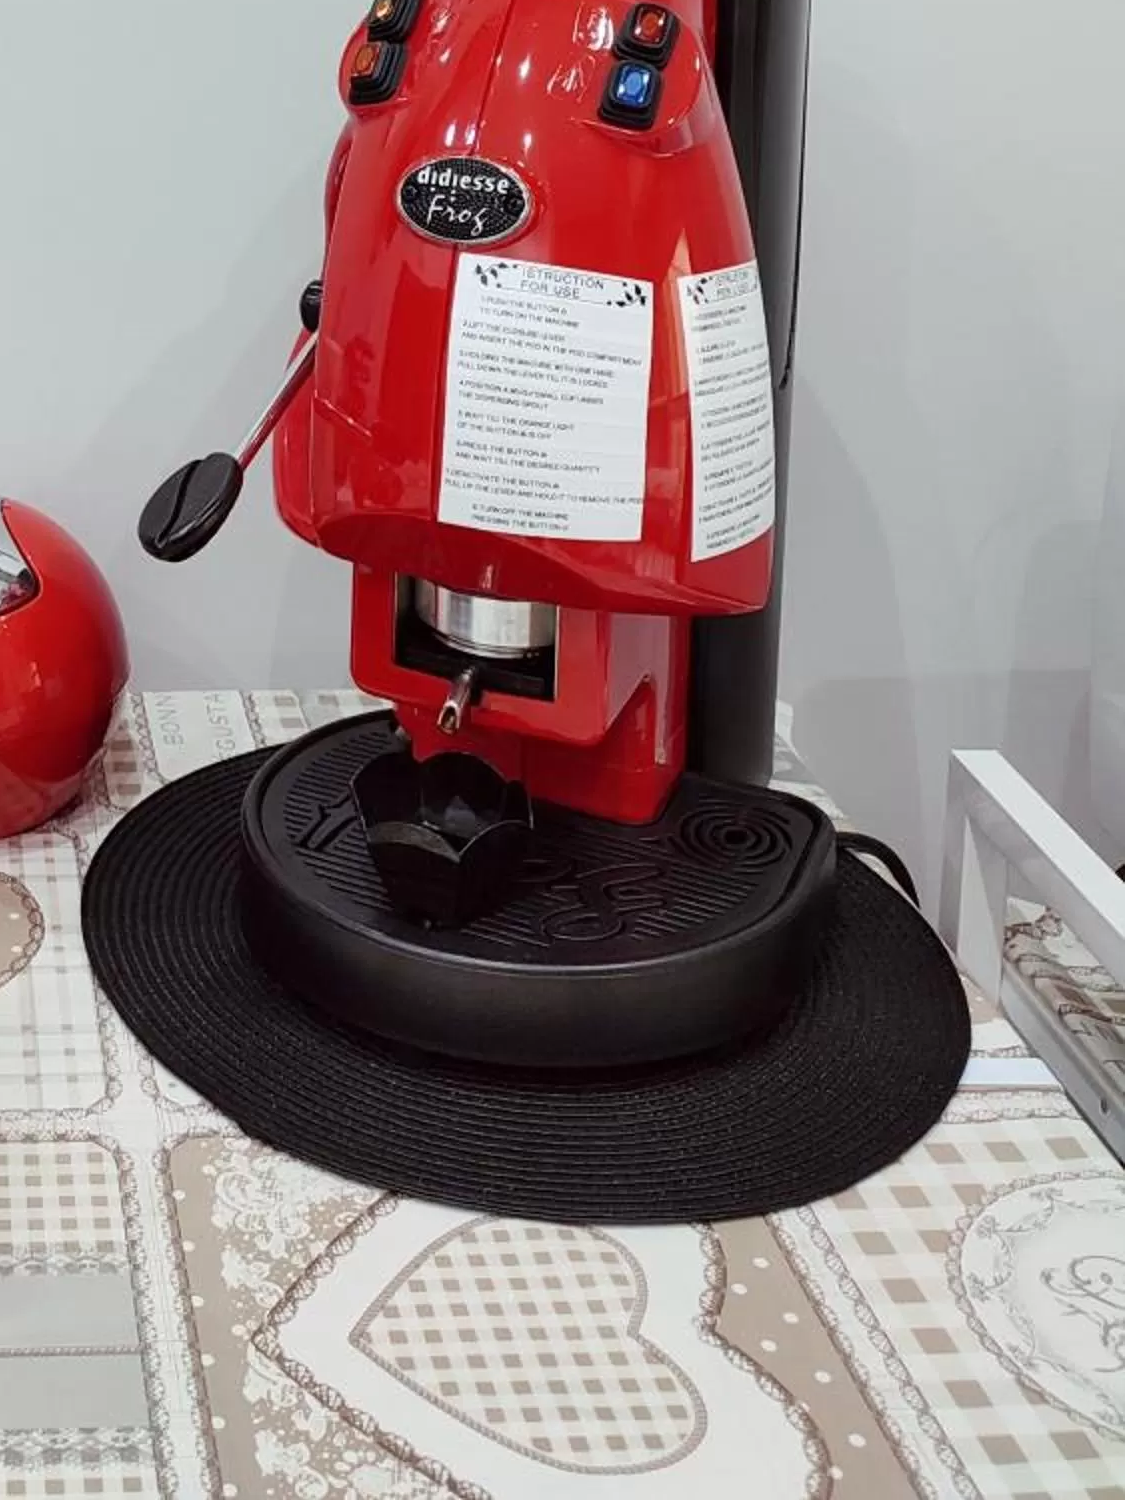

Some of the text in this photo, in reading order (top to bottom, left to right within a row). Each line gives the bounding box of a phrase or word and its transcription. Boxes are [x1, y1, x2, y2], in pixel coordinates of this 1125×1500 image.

[416, 165, 510, 196] didiesse
[426, 193, 492, 236] Frog
[520, 279, 581, 300] FOR USE
